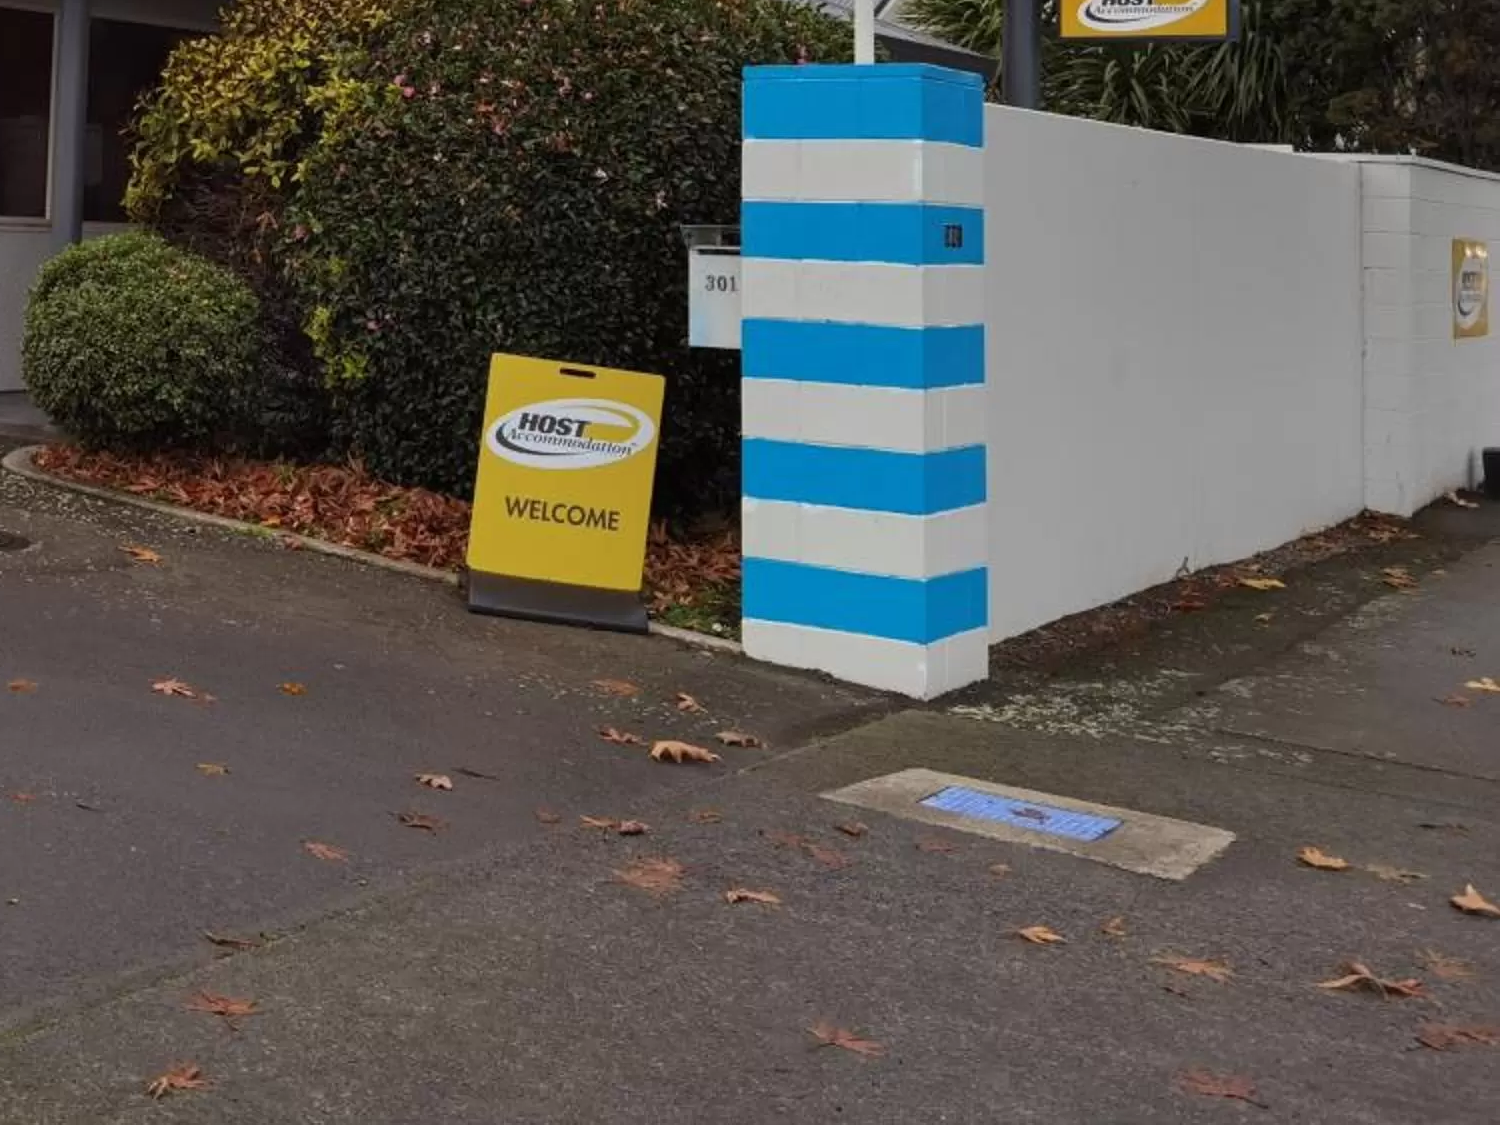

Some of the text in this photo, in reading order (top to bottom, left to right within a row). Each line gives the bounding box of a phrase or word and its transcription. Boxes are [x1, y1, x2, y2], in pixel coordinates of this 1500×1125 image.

[704, 275, 739, 292] 301
[517, 412, 592, 439] HOST
[505, 427, 633, 456] Accommodation
[504, 495, 621, 532] WELCOME
